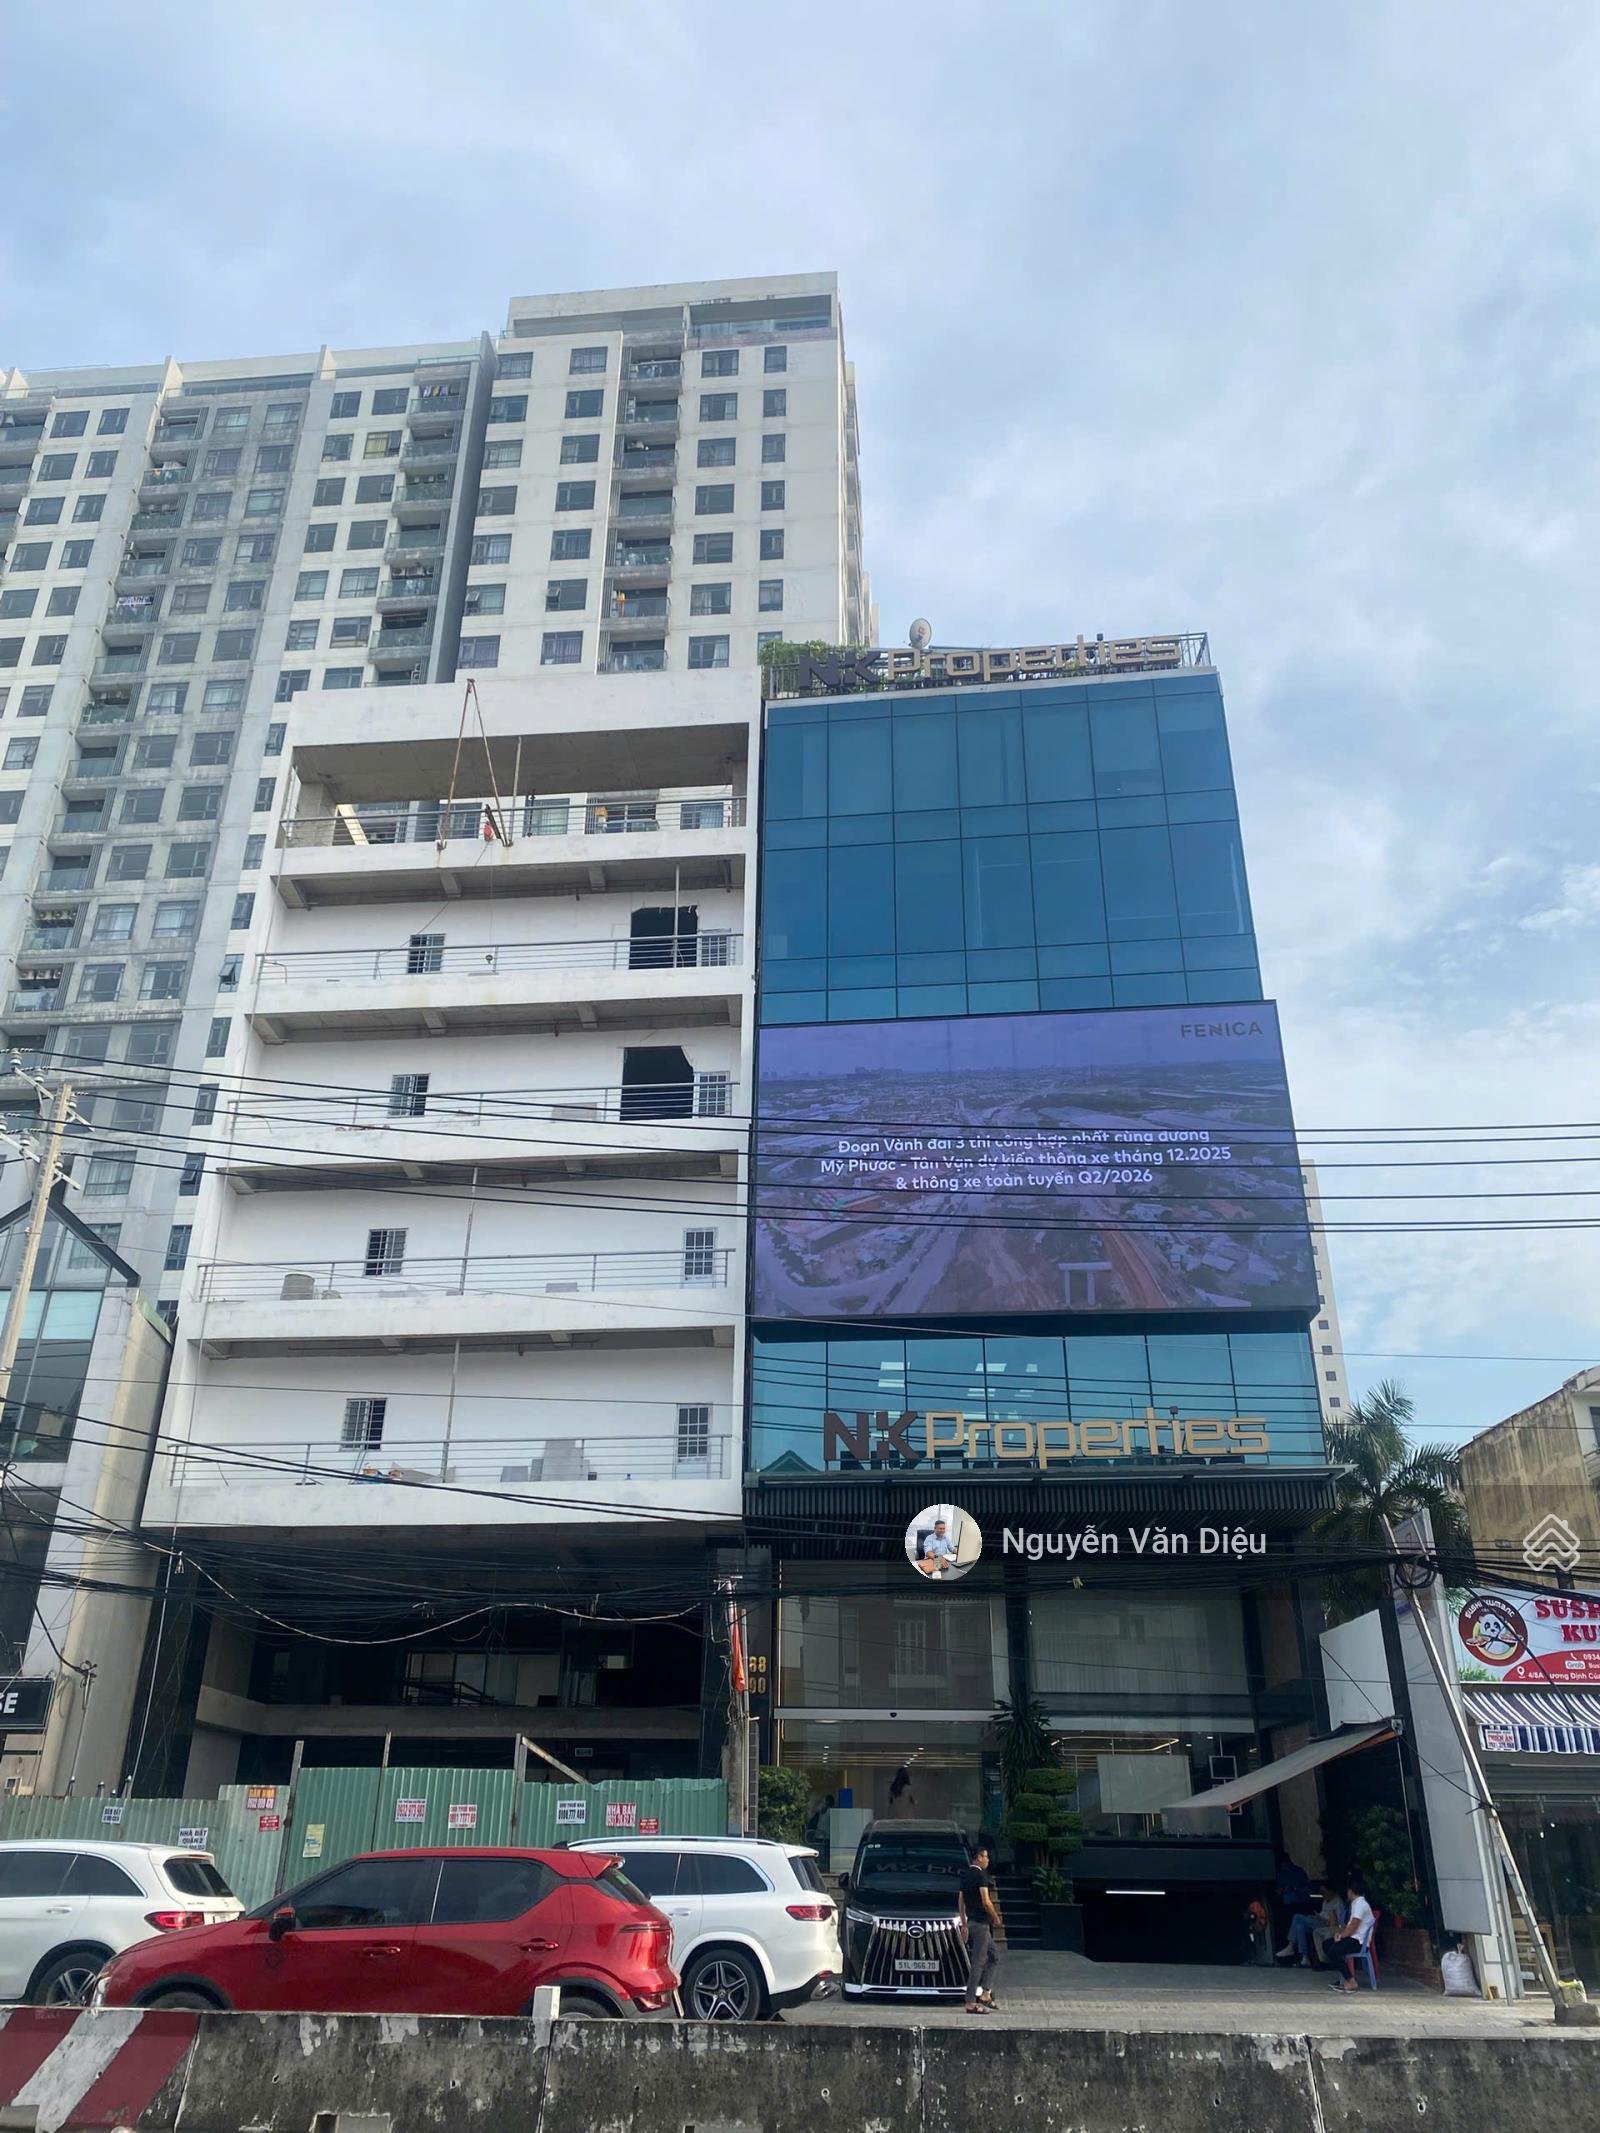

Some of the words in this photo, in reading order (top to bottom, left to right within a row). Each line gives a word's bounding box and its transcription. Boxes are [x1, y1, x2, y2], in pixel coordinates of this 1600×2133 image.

[1181, 1022, 1264, 1039] FENICA
[838, 1141, 879, 1156] Đoạn
[884, 1138, 923, 1152] Vành
[956, 1137, 965, 1149] 3
[821, 1158, 844, 1175] Mỹ
[849, 1157, 896, 1172] Phước
[1039, 1151, 1086, 1168] thông
[1092, 1153, 1110, 1164] xe
[1114, 1149, 1163, 1165] tháng
[1167, 1147, 1231, 1161] 12.2025
[896, 1177, 907, 1190] &
[912, 1176, 959, 1191] thông
[964, 1178, 981, 1188] xe
[985, 1173, 1023, 1187] toàn
[1028, 1170, 1073, 1188] tuyến
[1079, 1169, 1153, 1185] Q2/2026
